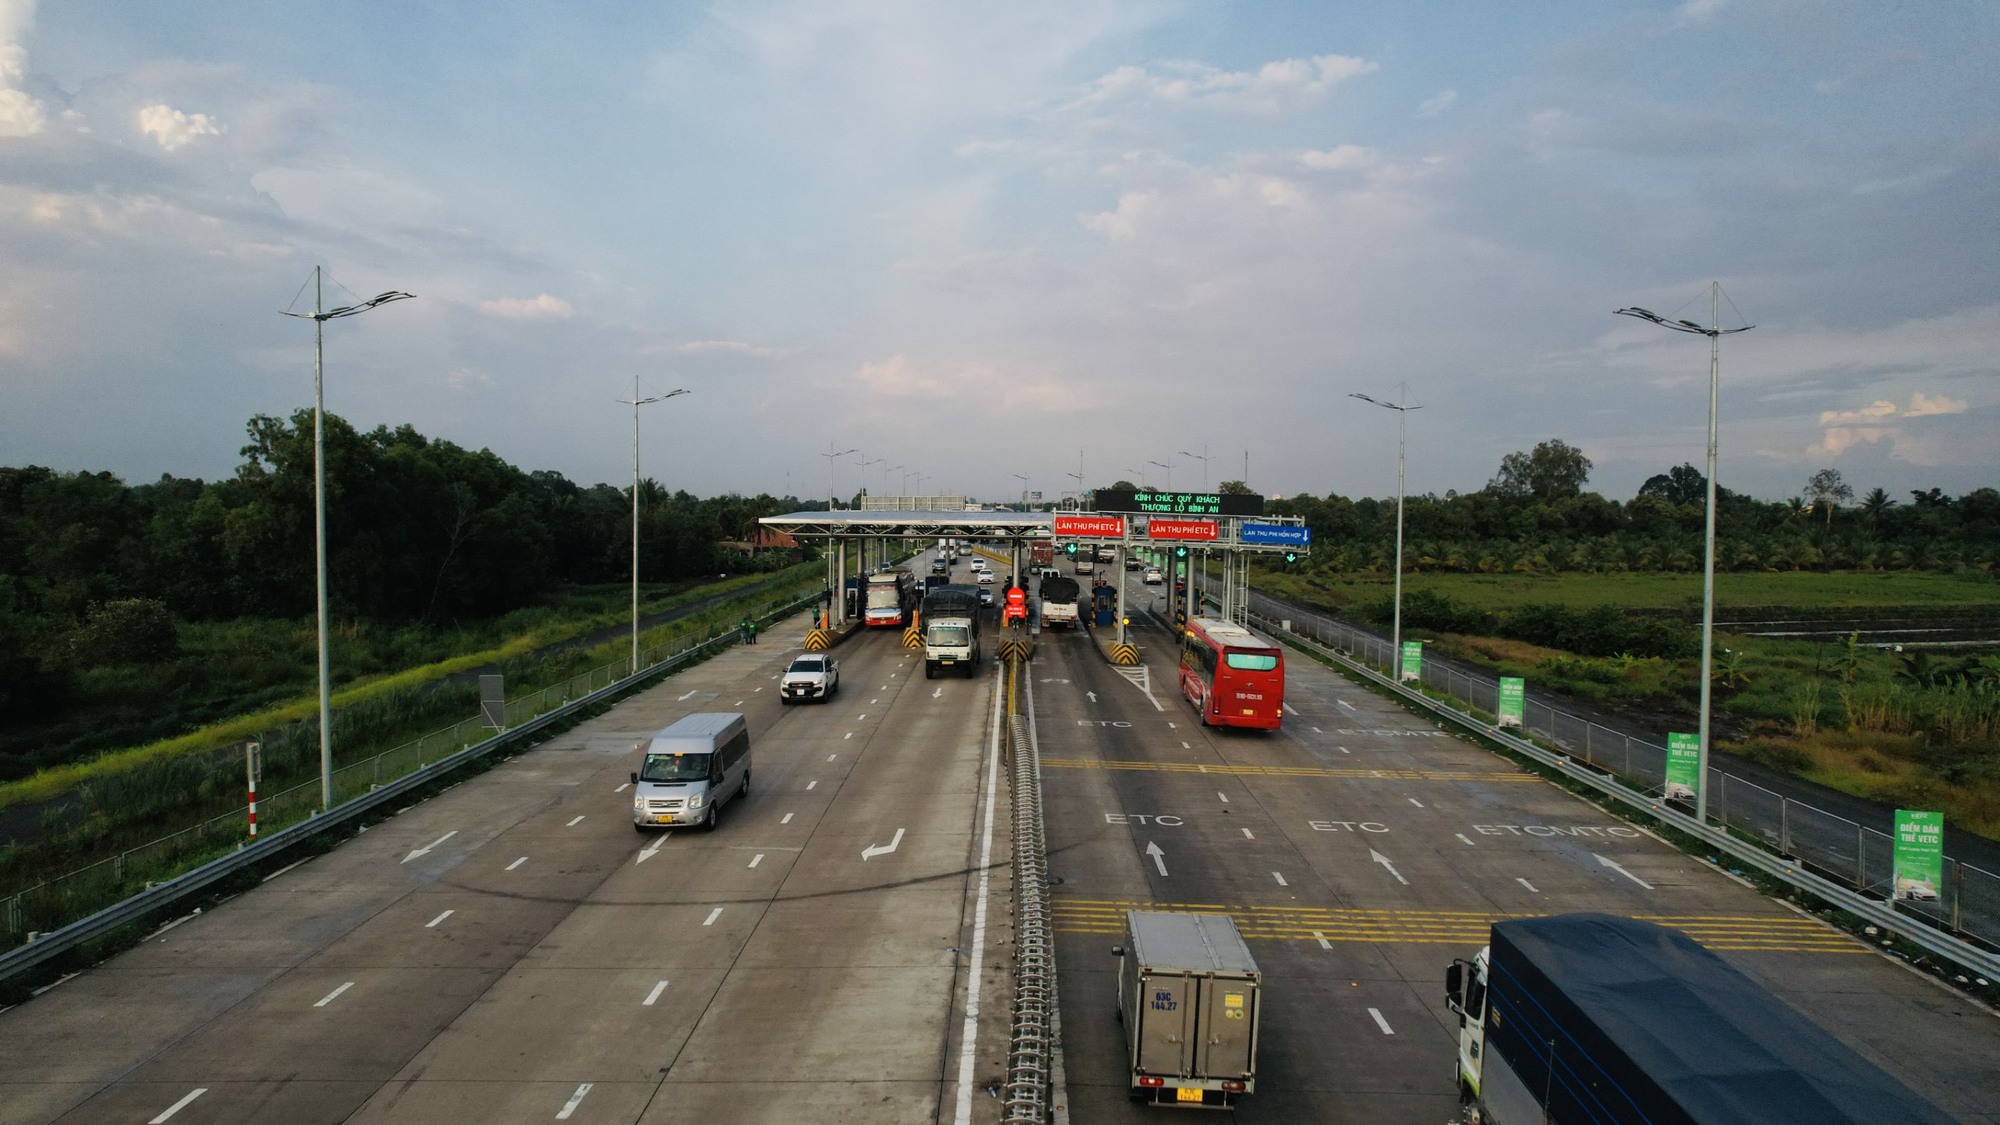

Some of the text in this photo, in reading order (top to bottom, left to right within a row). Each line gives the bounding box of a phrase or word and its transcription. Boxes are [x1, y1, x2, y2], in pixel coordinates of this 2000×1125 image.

[1134, 492, 1152, 501] KÍNH
[1155, 493, 1174, 502] CHÚC
[1196, 494, 1220, 504] KHÁCH
[1056, 520, 1072, 529] LÀN
[1088, 522, 1100, 530] PHÍ
[1151, 524, 1166, 532] LÀN
[1182, 526, 1194, 534] PHÍ
[1105, 814, 1184, 826] ETC
[1308, 820, 1390, 833] ETC
[1918, 835, 1938, 843] VETC
[1156, 992, 1172, 1001] 63C
[1151, 1002, 1178, 1010] 144.27
